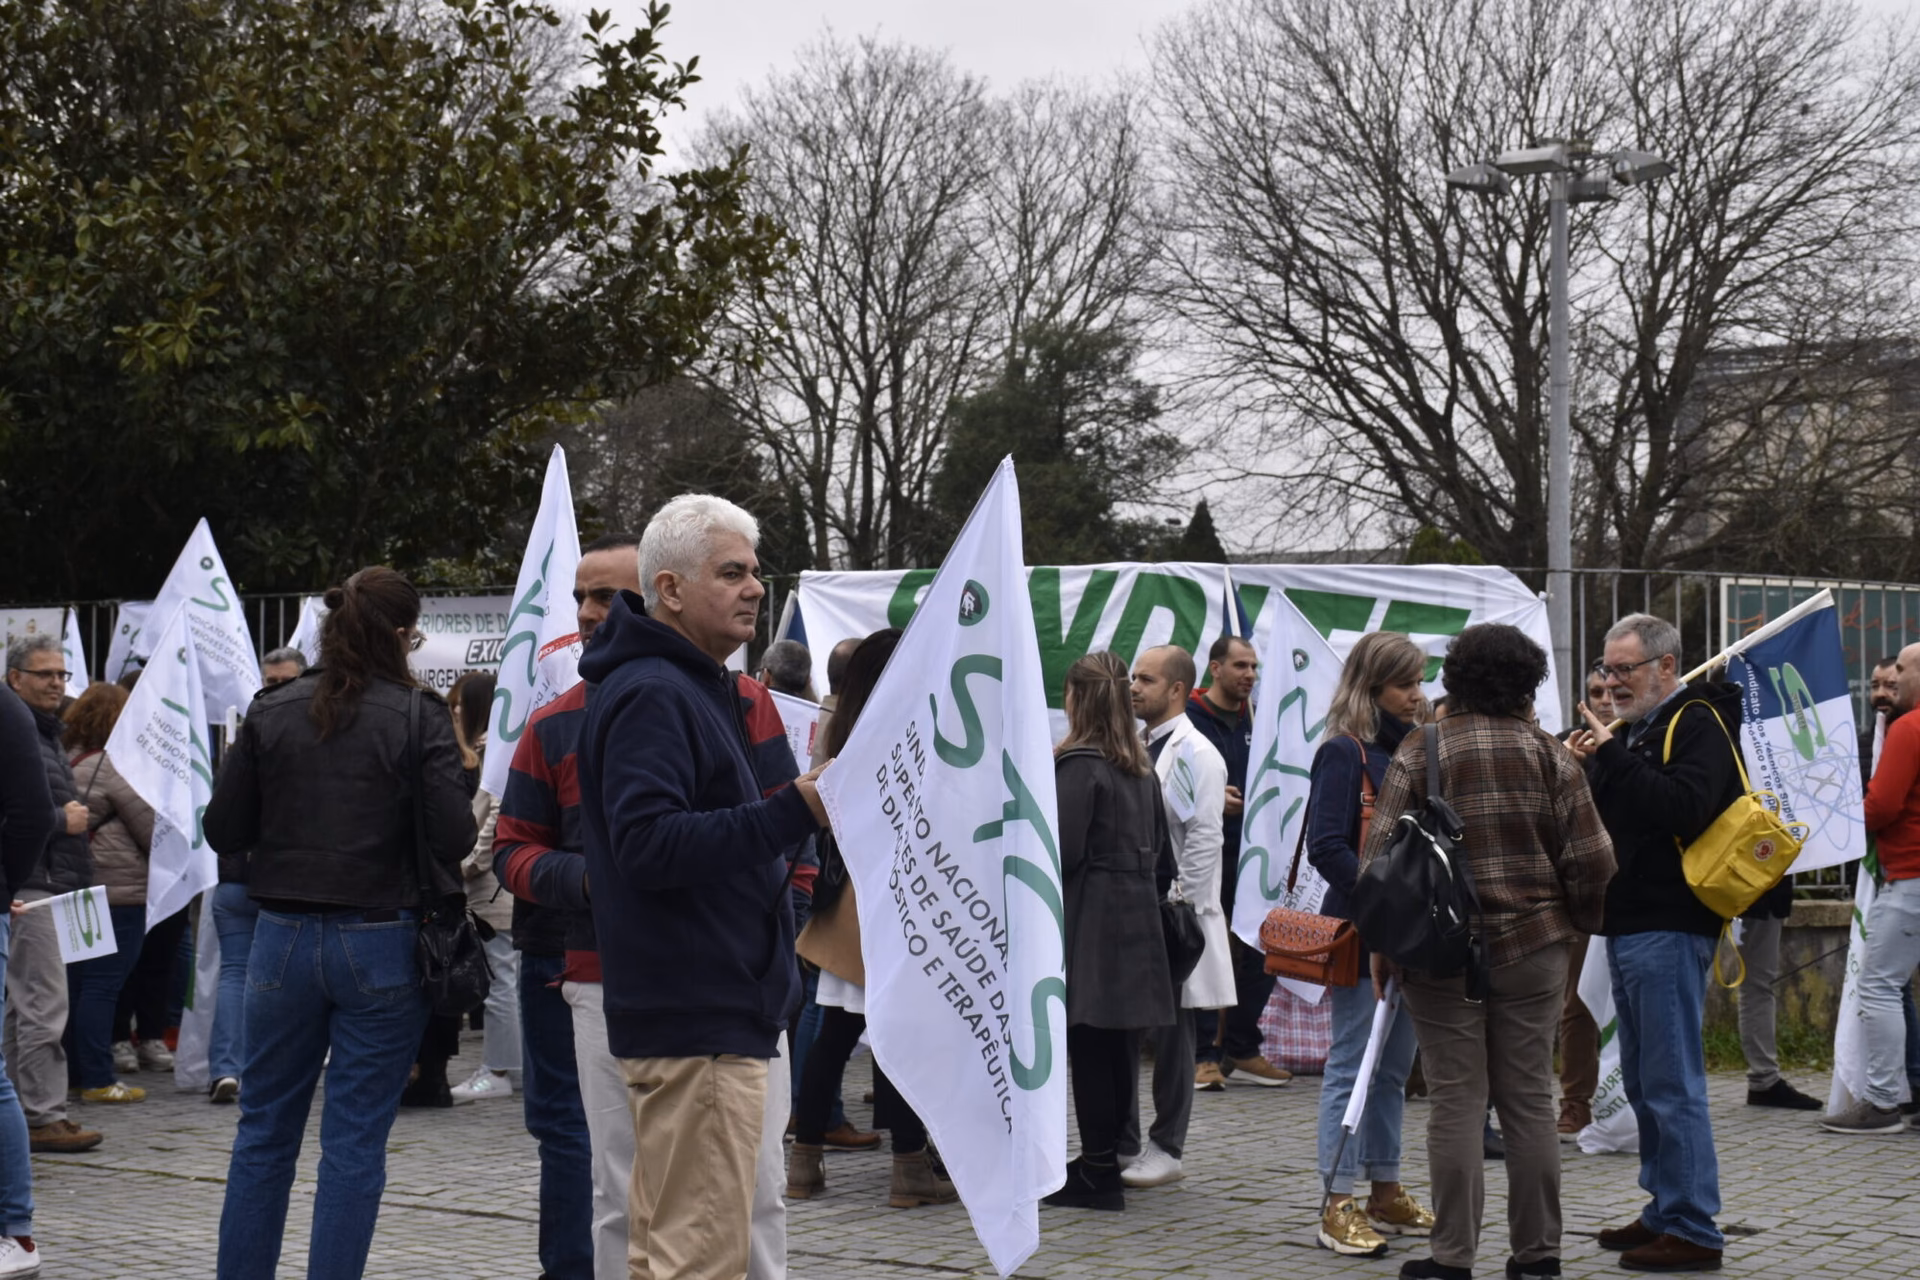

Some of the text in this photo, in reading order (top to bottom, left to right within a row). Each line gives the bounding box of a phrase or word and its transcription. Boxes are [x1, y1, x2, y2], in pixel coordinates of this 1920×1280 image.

[475, 613, 495, 633] DE
[876, 763, 890, 798] DE
[922, 956, 944, 977] E
[910, 874, 939, 912] DE
[932, 910, 997, 990] SAÚDE
